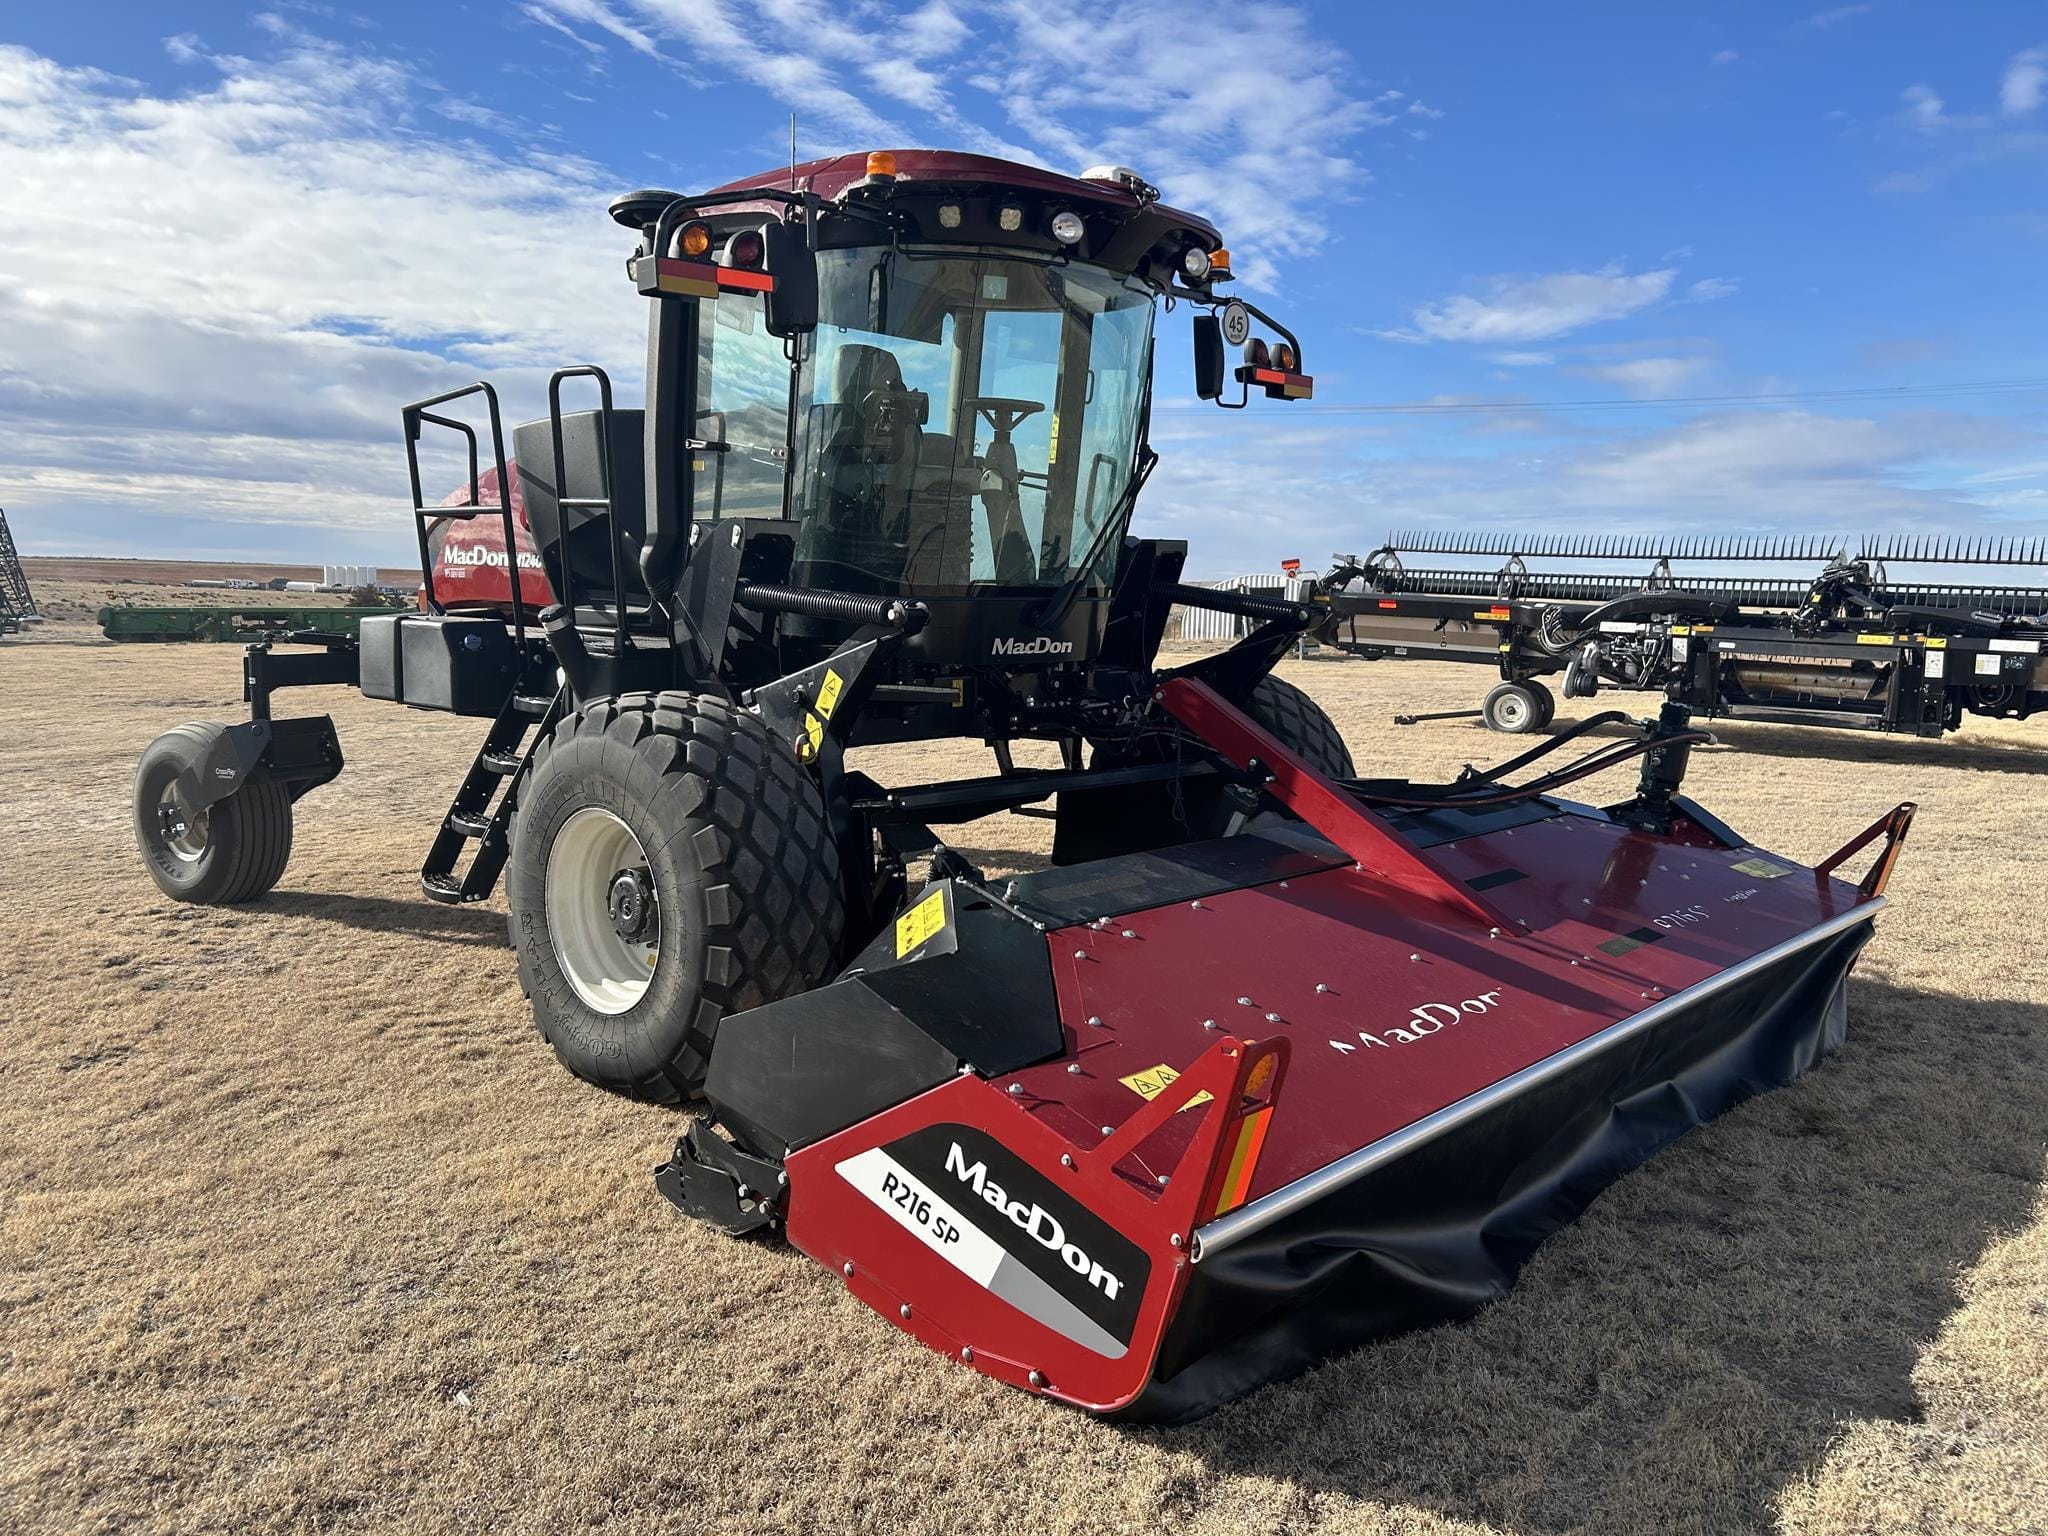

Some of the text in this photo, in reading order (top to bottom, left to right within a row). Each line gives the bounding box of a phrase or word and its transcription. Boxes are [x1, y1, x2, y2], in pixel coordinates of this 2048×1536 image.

[1229, 315, 1244, 333] 45
[444, 544, 510, 567] MacDon
[992, 637, 1073, 656] MacDon
[1328, 990, 1501, 1055] MacDon
[881, 1171, 961, 1245] R216 SP
[944, 1141, 1122, 1301] MacDon
